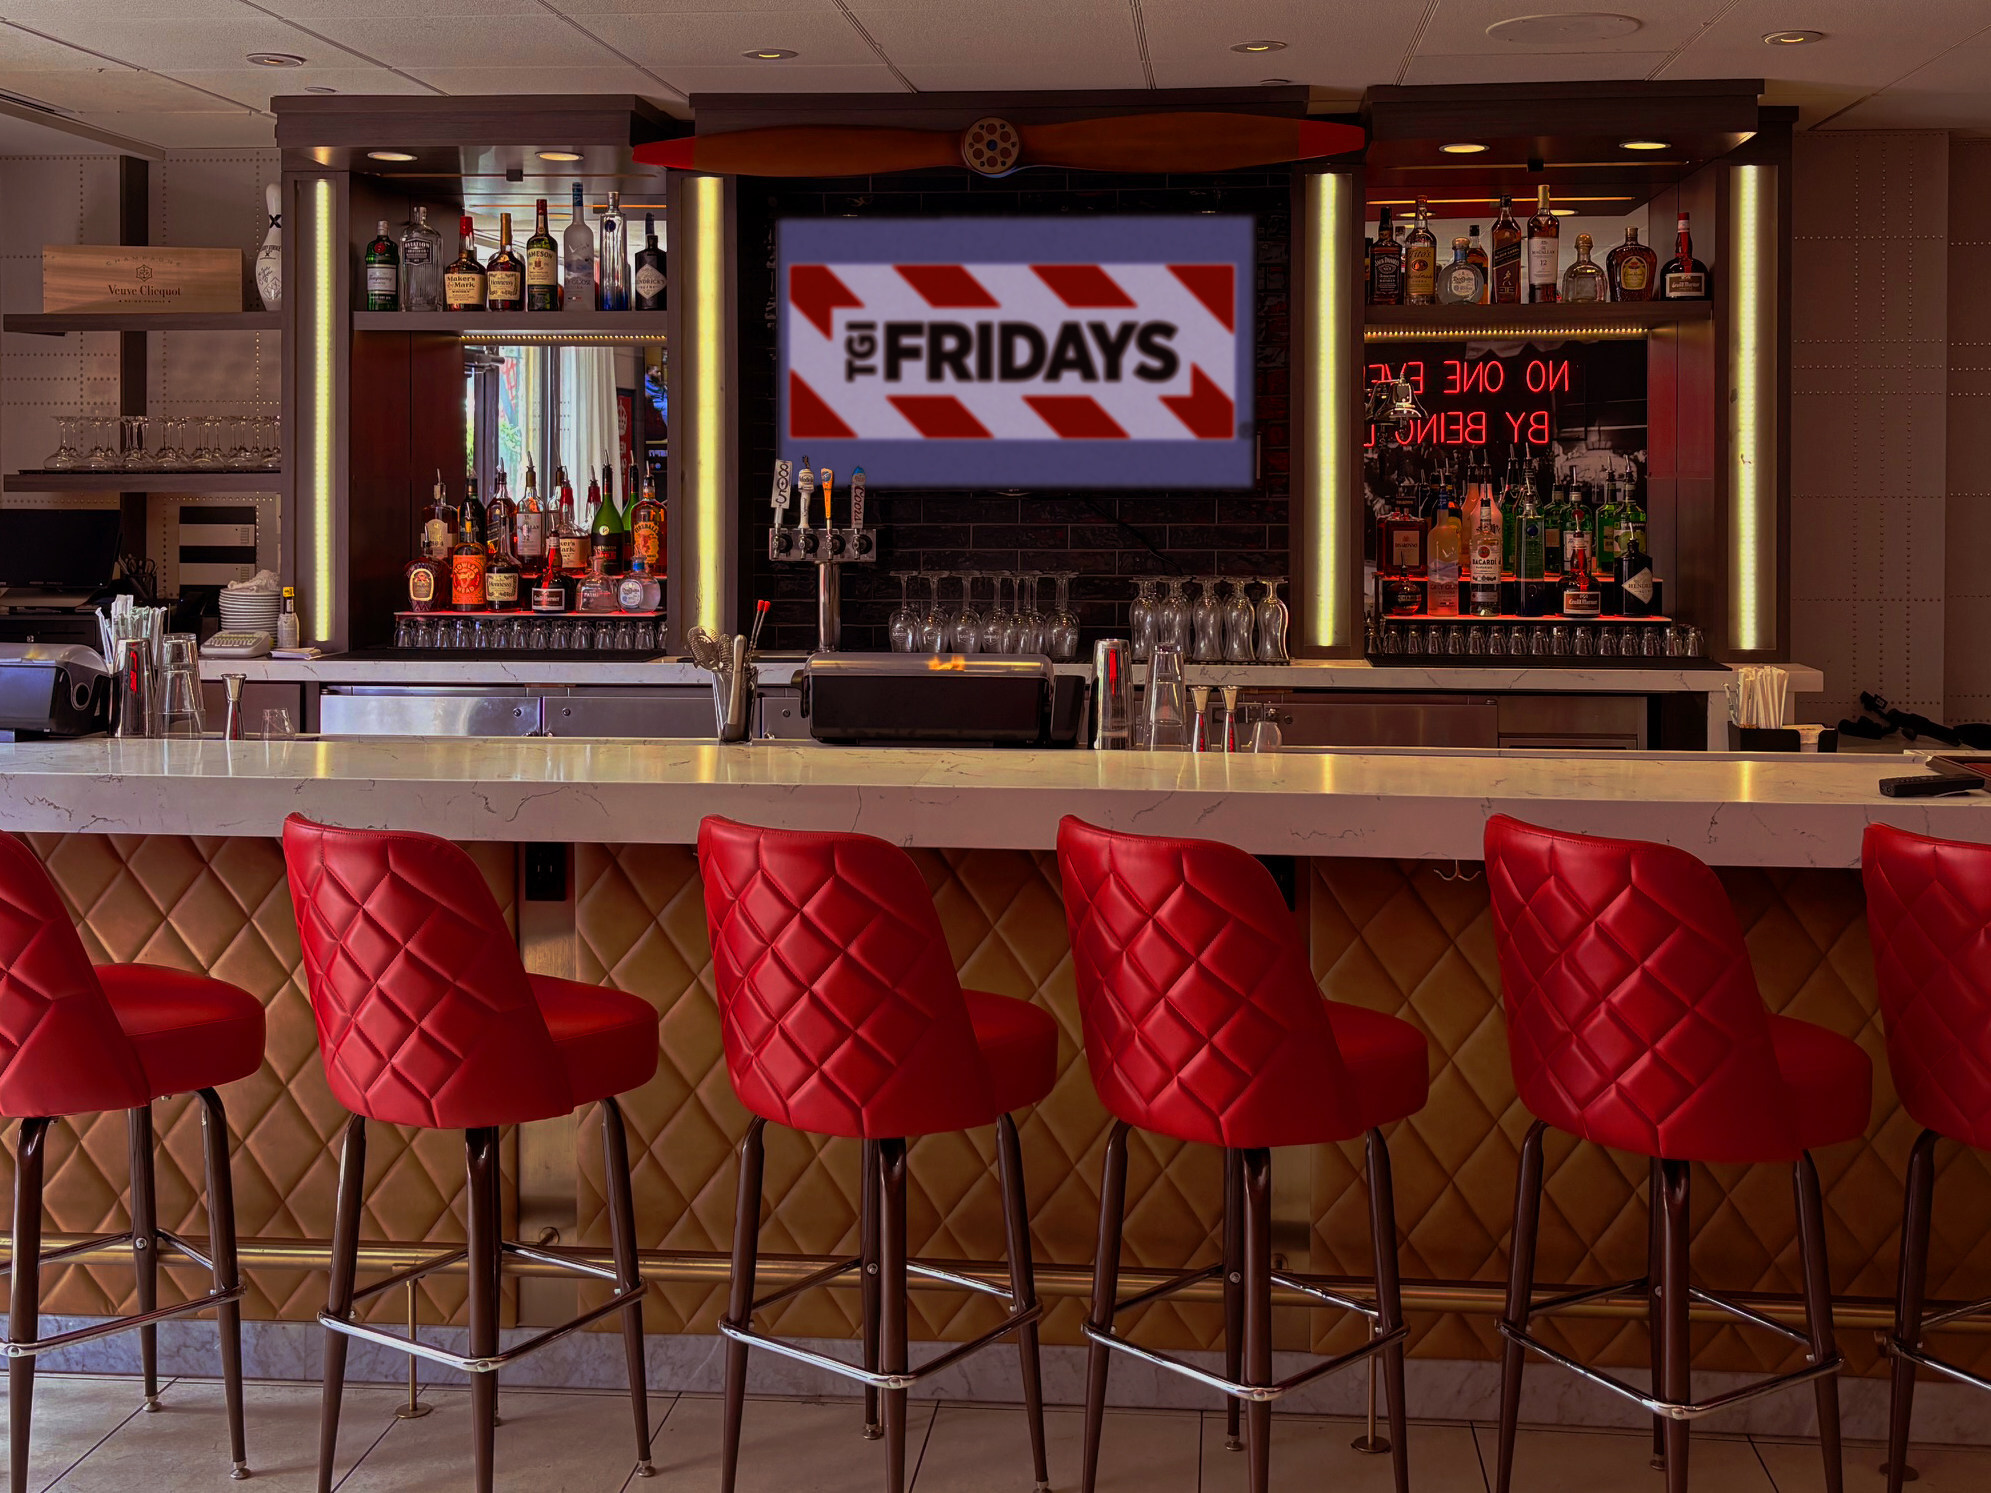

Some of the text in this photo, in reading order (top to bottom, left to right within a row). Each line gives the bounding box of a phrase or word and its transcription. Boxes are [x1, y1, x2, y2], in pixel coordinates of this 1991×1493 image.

[527, 250, 554, 259] AMESON
[1408, 250, 1432, 259] Tito's
[105, 255, 182, 267] CHAMPAGNE
[1539, 259, 1547, 267] 12
[447, 275, 476, 283] Maker's
[454, 281, 476, 289] Mark
[108, 284, 182, 298] Veuve Clicquot
[846, 319, 1180, 384] TGI FRIDAYS
[853, 485, 866, 522] Coors
[453, 561, 479, 574] HOWLER
[456, 584, 475, 594] HEAD
